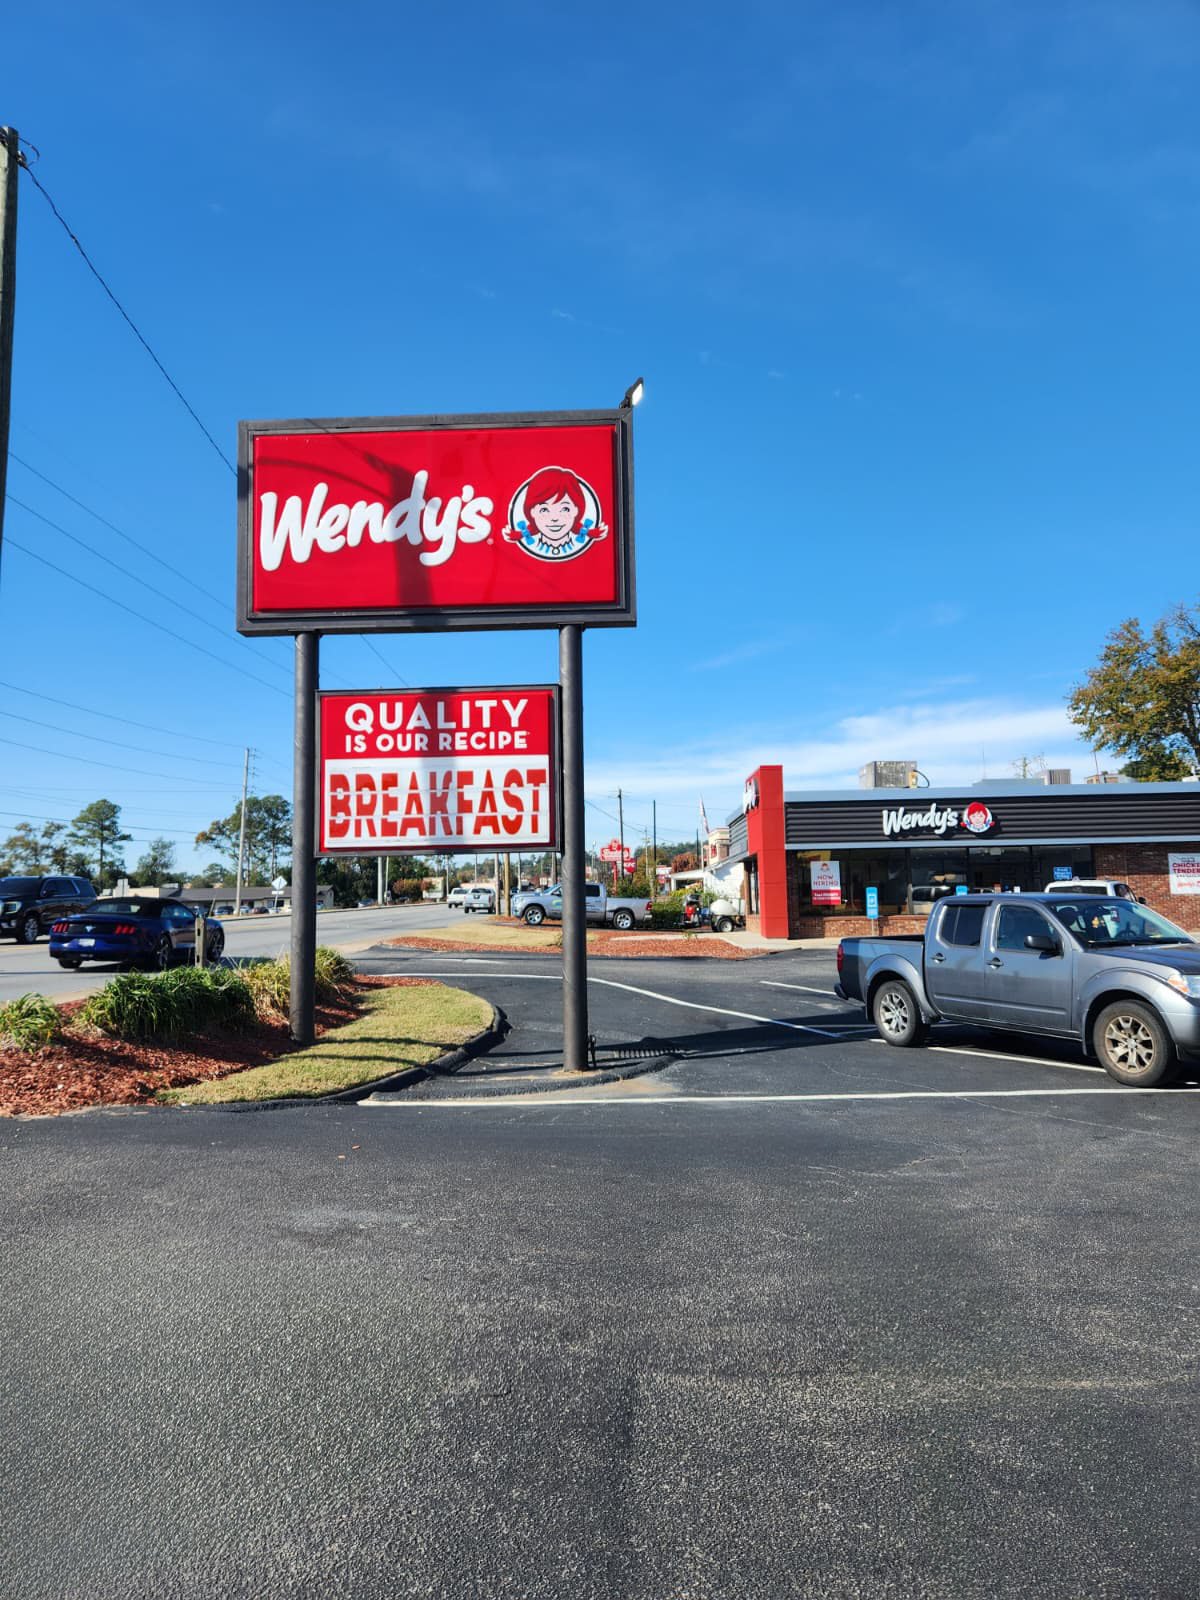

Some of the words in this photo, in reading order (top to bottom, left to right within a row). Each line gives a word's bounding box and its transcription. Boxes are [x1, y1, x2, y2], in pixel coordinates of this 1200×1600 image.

[260, 469, 494, 571] Wendy's
[344, 699, 529, 734] QUALITY
[345, 734, 367, 753] IS
[376, 732, 429, 752] OUR
[438, 730, 528, 750] RECIPE
[329, 768, 547, 838] BREAKFAST
[882, 802, 958, 835] Wendy's
